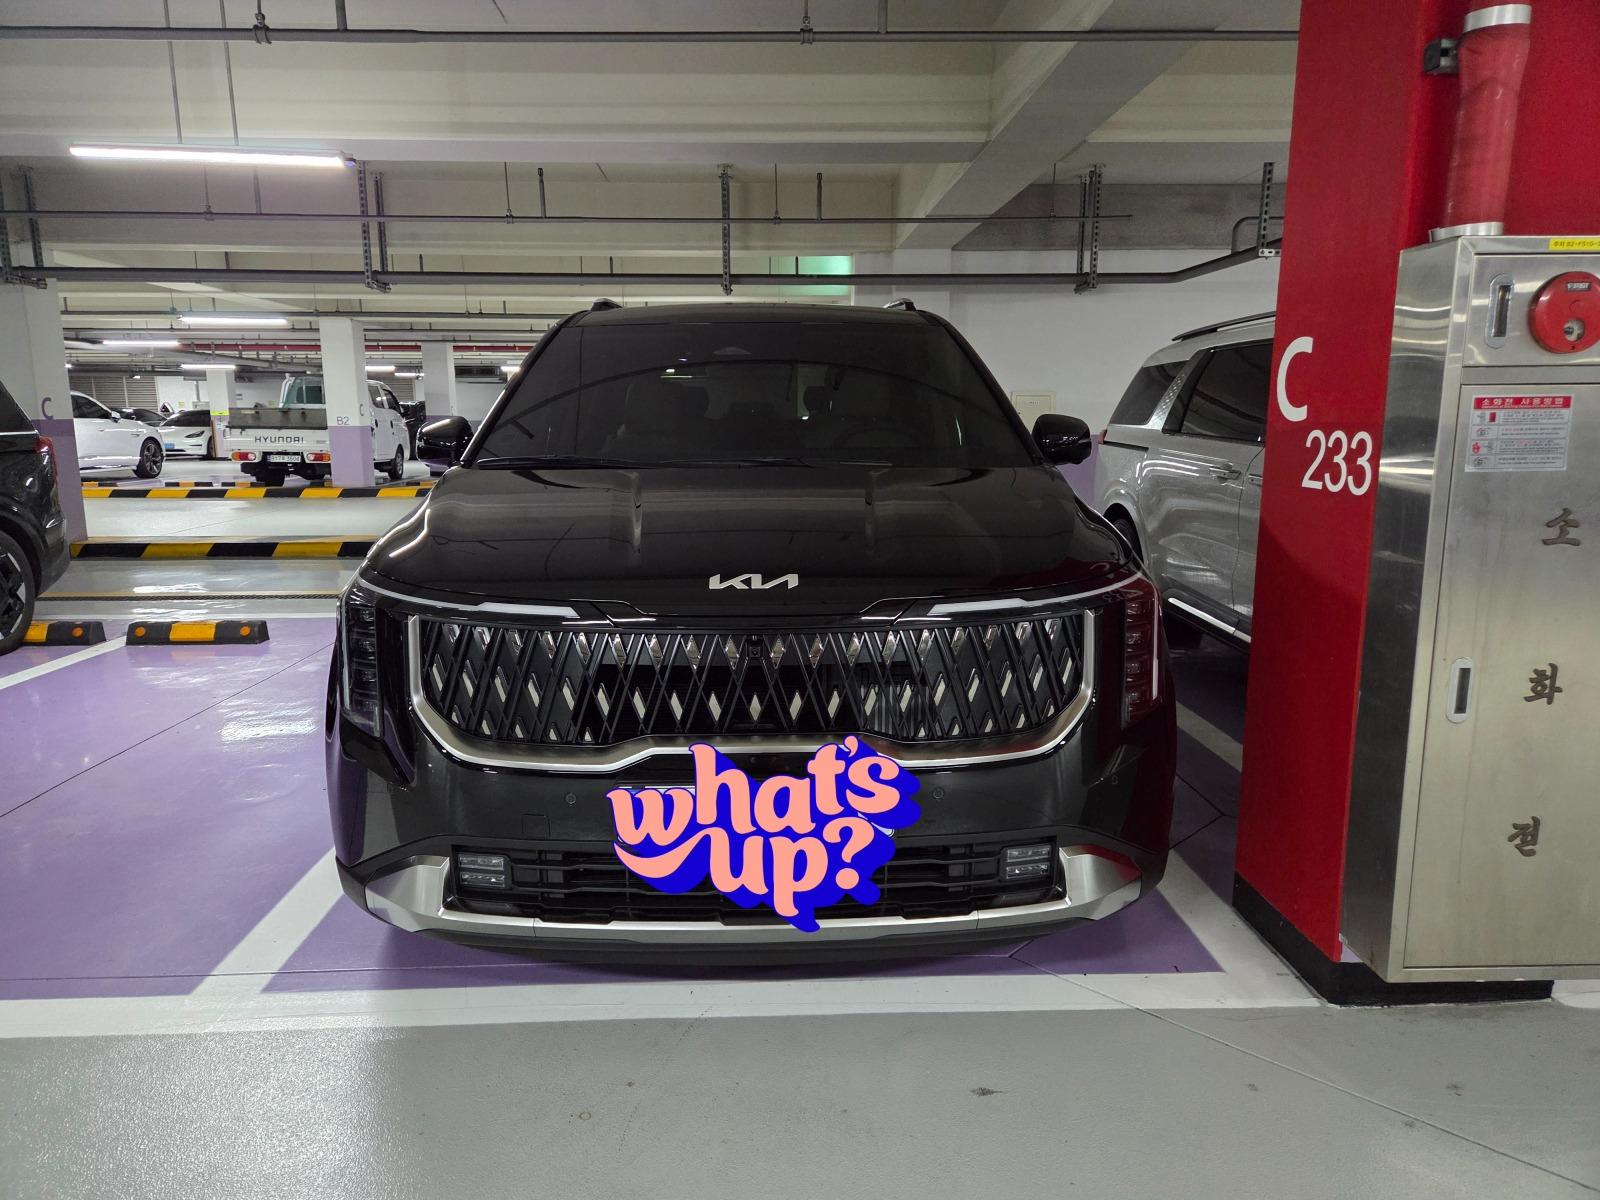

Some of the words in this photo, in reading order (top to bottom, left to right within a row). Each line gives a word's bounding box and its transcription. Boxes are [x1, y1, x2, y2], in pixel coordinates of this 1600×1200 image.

[1277, 336, 1314, 422] C
[41, 397, 54, 420] C
[336, 416, 350, 426] B2
[254, 435, 305, 444] HYUNDAI
[1302, 429, 1373, 496] 233
